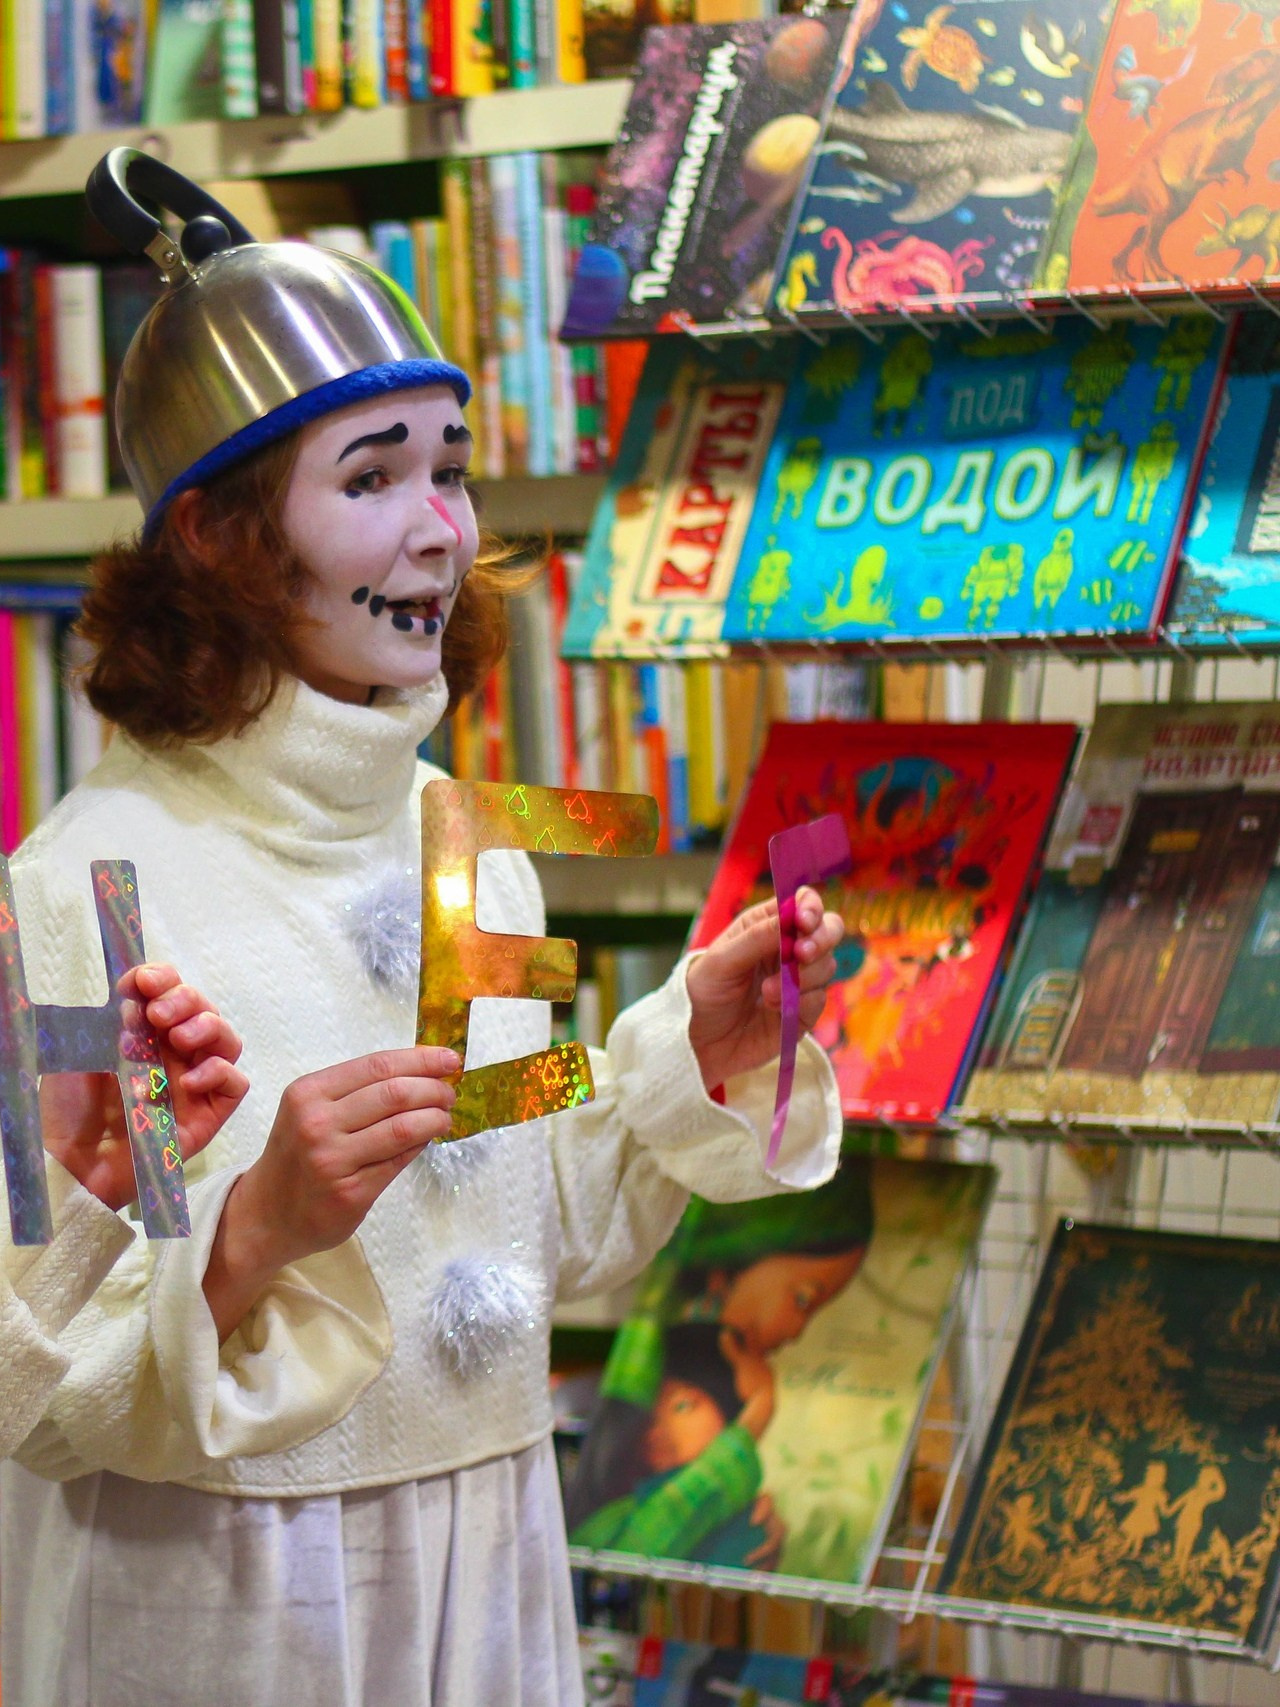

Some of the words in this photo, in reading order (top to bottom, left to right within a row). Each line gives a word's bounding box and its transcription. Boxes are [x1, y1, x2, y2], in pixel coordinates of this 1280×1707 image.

[629, 39, 739, 305] Планетариум
[653, 383, 769, 602] КАРТЫ
[815, 432, 1126, 536] ВОДОЙ
